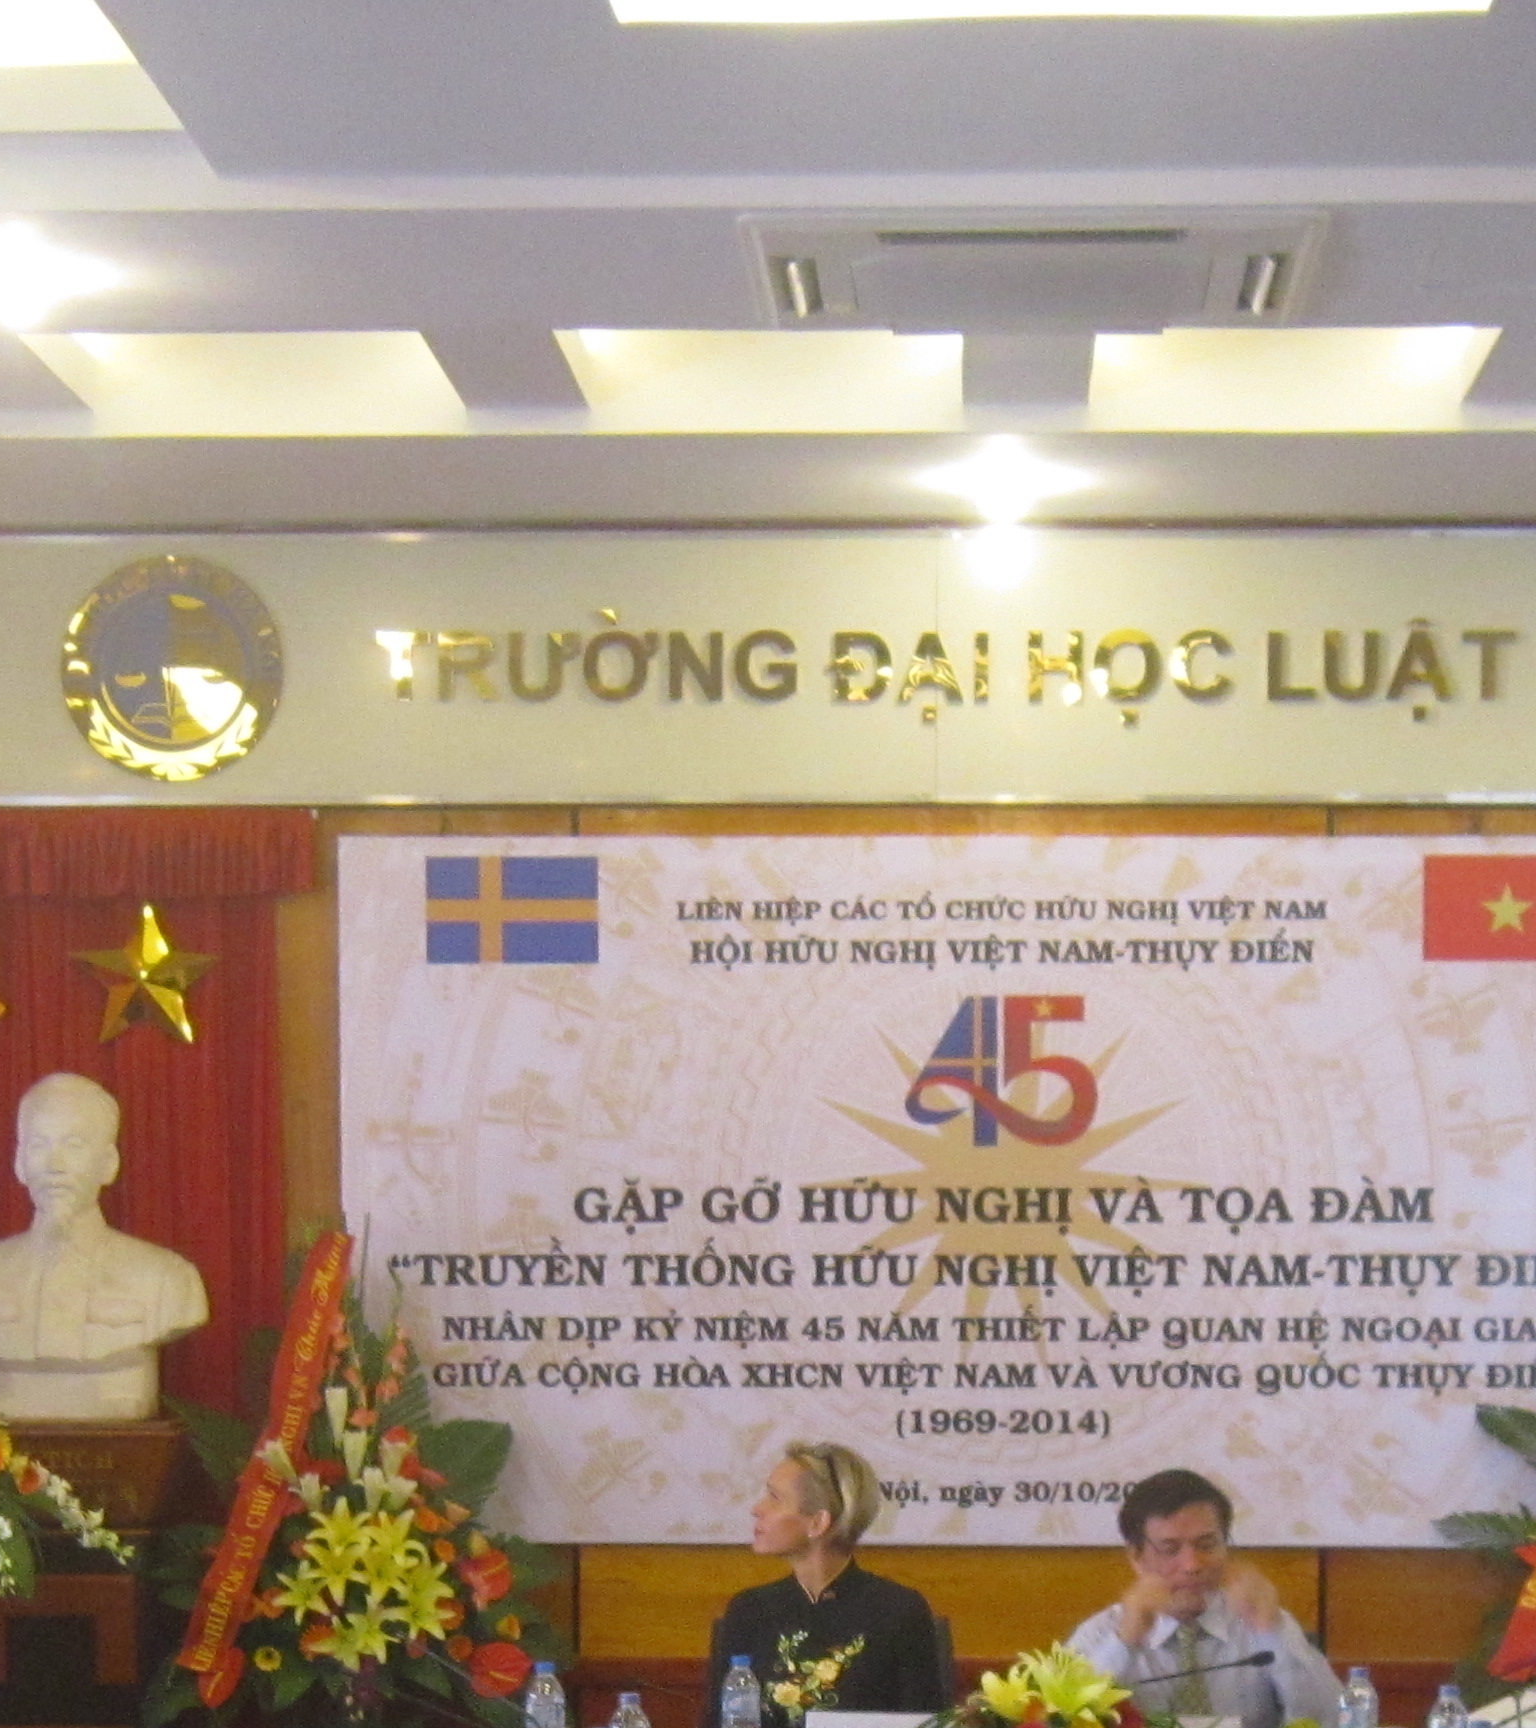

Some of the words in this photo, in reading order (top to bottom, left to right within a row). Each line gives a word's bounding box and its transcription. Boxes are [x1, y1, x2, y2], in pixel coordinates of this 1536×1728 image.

[374, 608, 798, 704] TRƯỜNG
[831, 628, 989, 724] ĐẠI
[1028, 628, 1236, 724] HỌC
[1266, 617, 1517, 723] LUẬT
[676, 896, 743, 921] LIÊN
[753, 896, 822, 927] HIỆP
[830, 894, 888, 921] CÁC
[945, 892, 1026, 920] CHỨC
[1034, 894, 1096, 920] HỮU
[1107, 898, 1179, 926] NGHỊ
[1188, 895, 1256, 926] VIỆT
[1265, 899, 1328, 921] NAM
[690, 933, 753, 971] HỘI
[764, 934, 839, 964] HỮU
[851, 938, 937, 971] NGHỊ
[947, 933, 1028, 971] VIỆT
[1038, 937, 1220, 972] NAM-THỤY
[905, 994, 1098, 1147] 45
[573, 1179, 684, 1236] GẶP
[701, 1177, 782, 1224] GỠ
[798, 1177, 917, 1224] HỮU
[935, 1186, 1074, 1236] NGHỊ
[1089, 1175, 1165, 1225] VÀ
[1179, 1186, 1294, 1236] TỌA
[1310, 1176, 1435, 1225] ĐÀM
[622, 1235, 796, 1287] THỐNG
[812, 1245, 918, 1287] HỮU
[934, 1254, 1058, 1298] NGHỊ
[1071, 1246, 1188, 1298] VIỆT
[1202, 1253, 1462, 1298] NAM-THỤY
[442, 1308, 546, 1342] NHÂN
[558, 1316, 622, 1350] DỊP
[634, 1308, 684, 1342] KỶ
[694, 1309, 790, 1350] NIỆM
[801, 1315, 846, 1342] 45
[857, 1310, 941, 1342] NĂM
[952, 1303, 1068, 1342] THIẾT
[1077, 1310, 1151, 1350] LẬP
[1162, 1317, 1265, 1350] QUAN
[1277, 1308, 1329, 1350] HỆ
[1342, 1316, 1463, 1350] NGOẠI
[433, 1355, 528, 1388] GIỮA
[537, 1356, 641, 1396] CỘNG
[654, 1354, 732, 1388] HÒA
[741, 1362, 844, 1388] XHCN
[854, 1356, 944, 1396] VIỆT
[954, 1362, 1038, 1388] NAM
[1047, 1356, 1099, 1389] VÀ
[1108, 1359, 1243, 1389] VƯƠNG
[1255, 1351, 1361, 1396] QUỐC
[1372, 1362, 1475, 1397] THỤY
[895, 1409, 1112, 1438] (1969-2014)
[939, 1480, 1006, 1509] ngày
